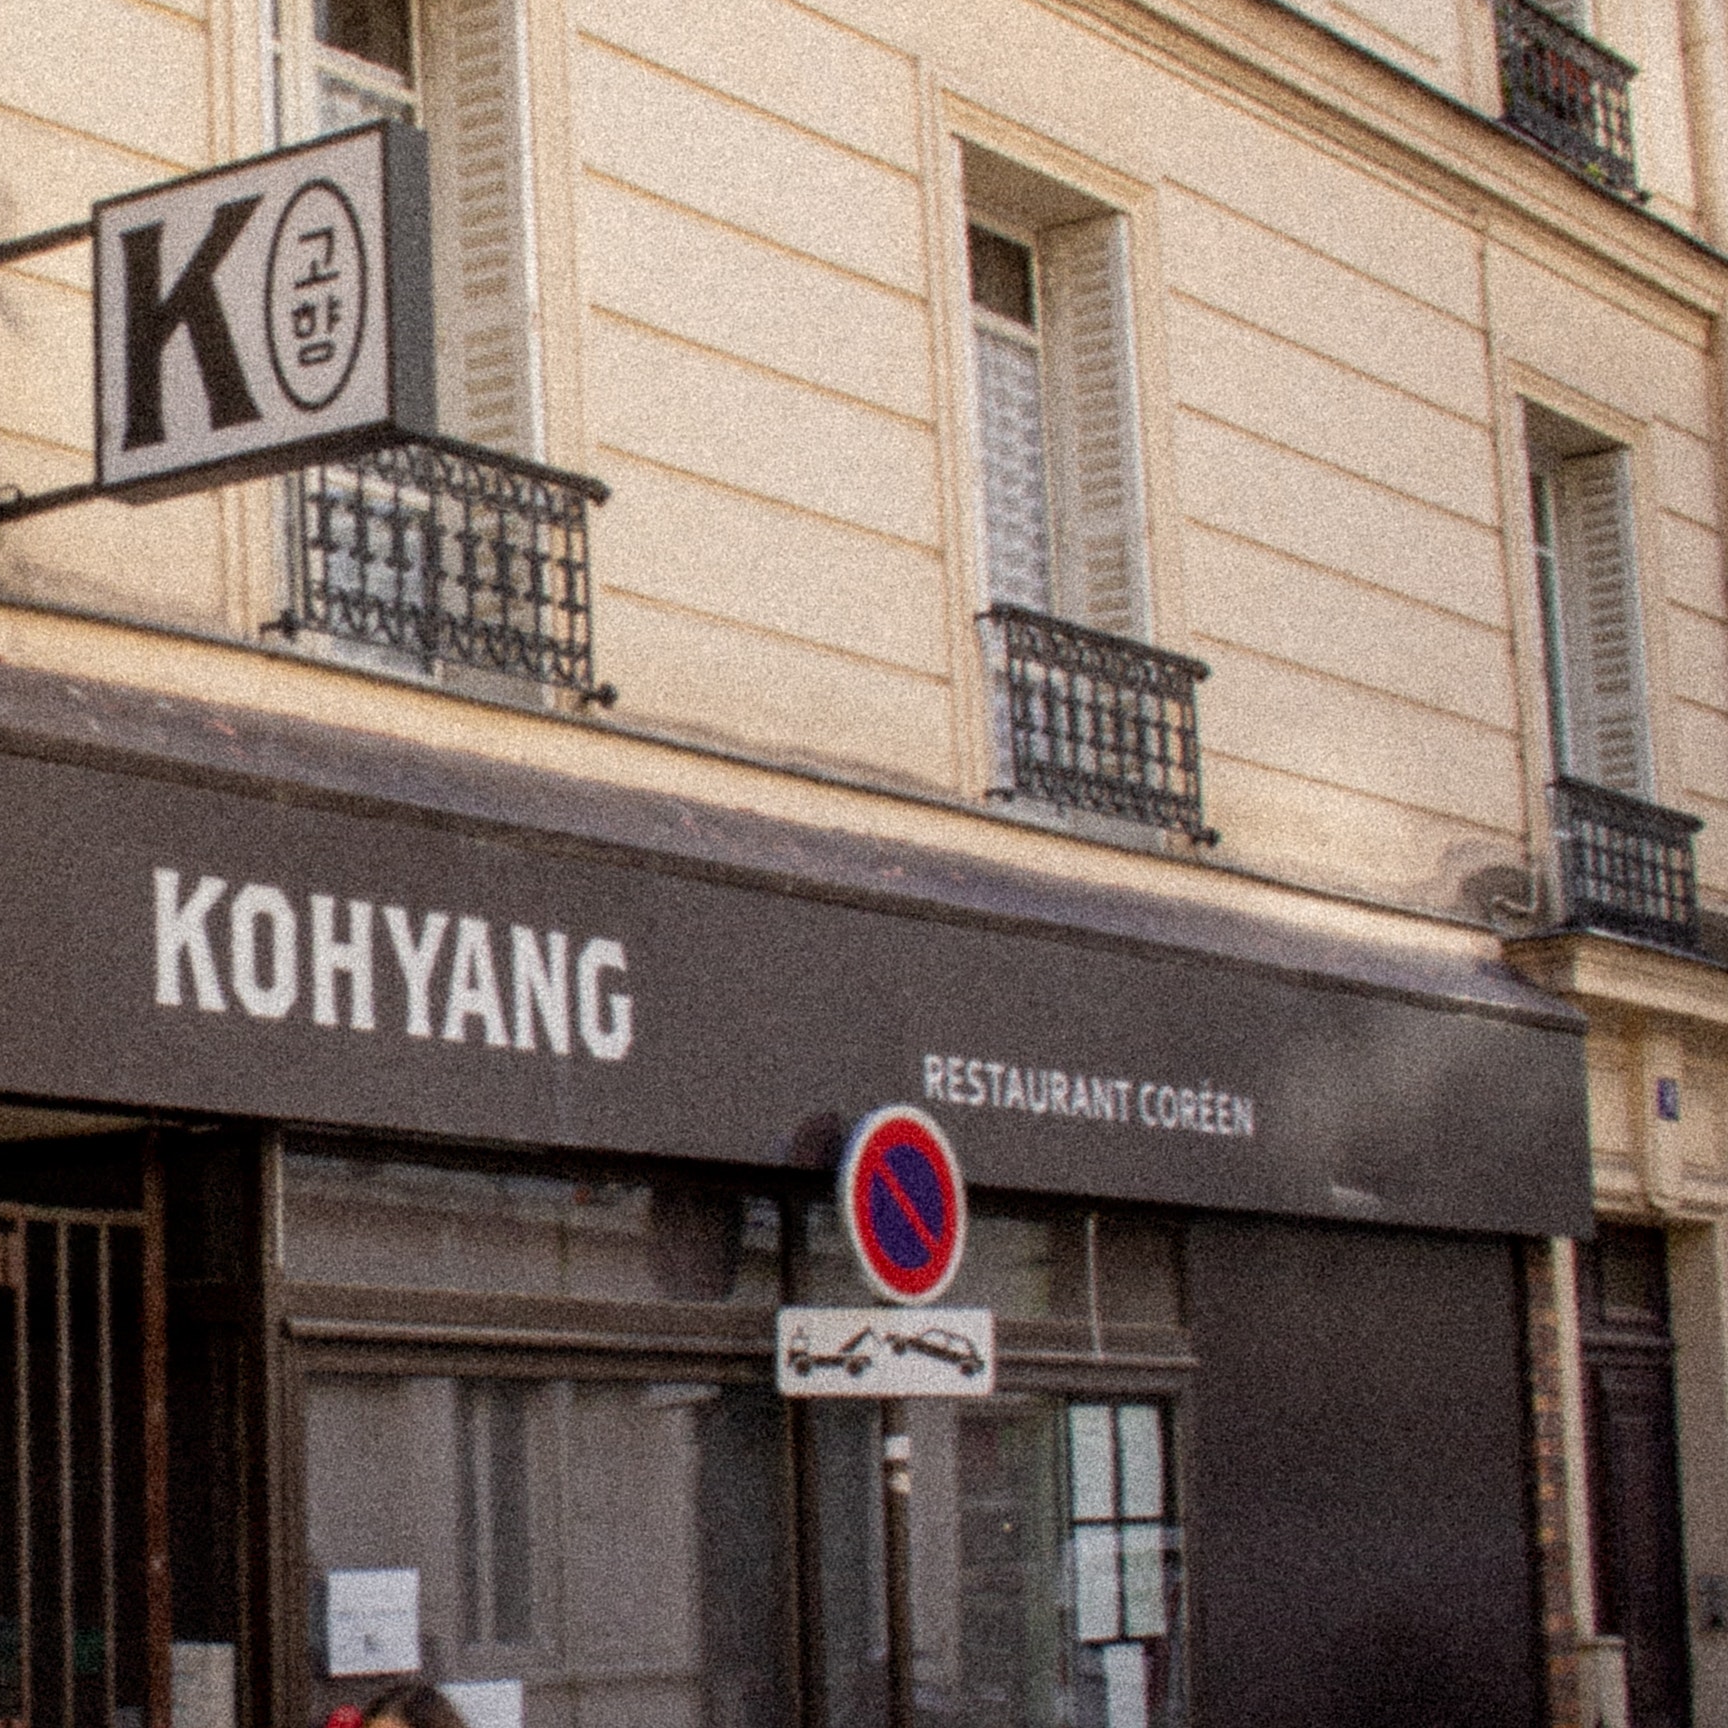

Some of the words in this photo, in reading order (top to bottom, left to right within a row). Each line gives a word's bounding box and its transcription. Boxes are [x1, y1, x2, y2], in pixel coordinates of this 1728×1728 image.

[119, 192, 266, 453] K
[290, 225, 342, 368] 고향
[153, 867, 634, 1061] KOHYANG
[923, 1053, 1134, 1122] RESTAURANT
[1138, 1078, 1256, 1137] CORÉEN
